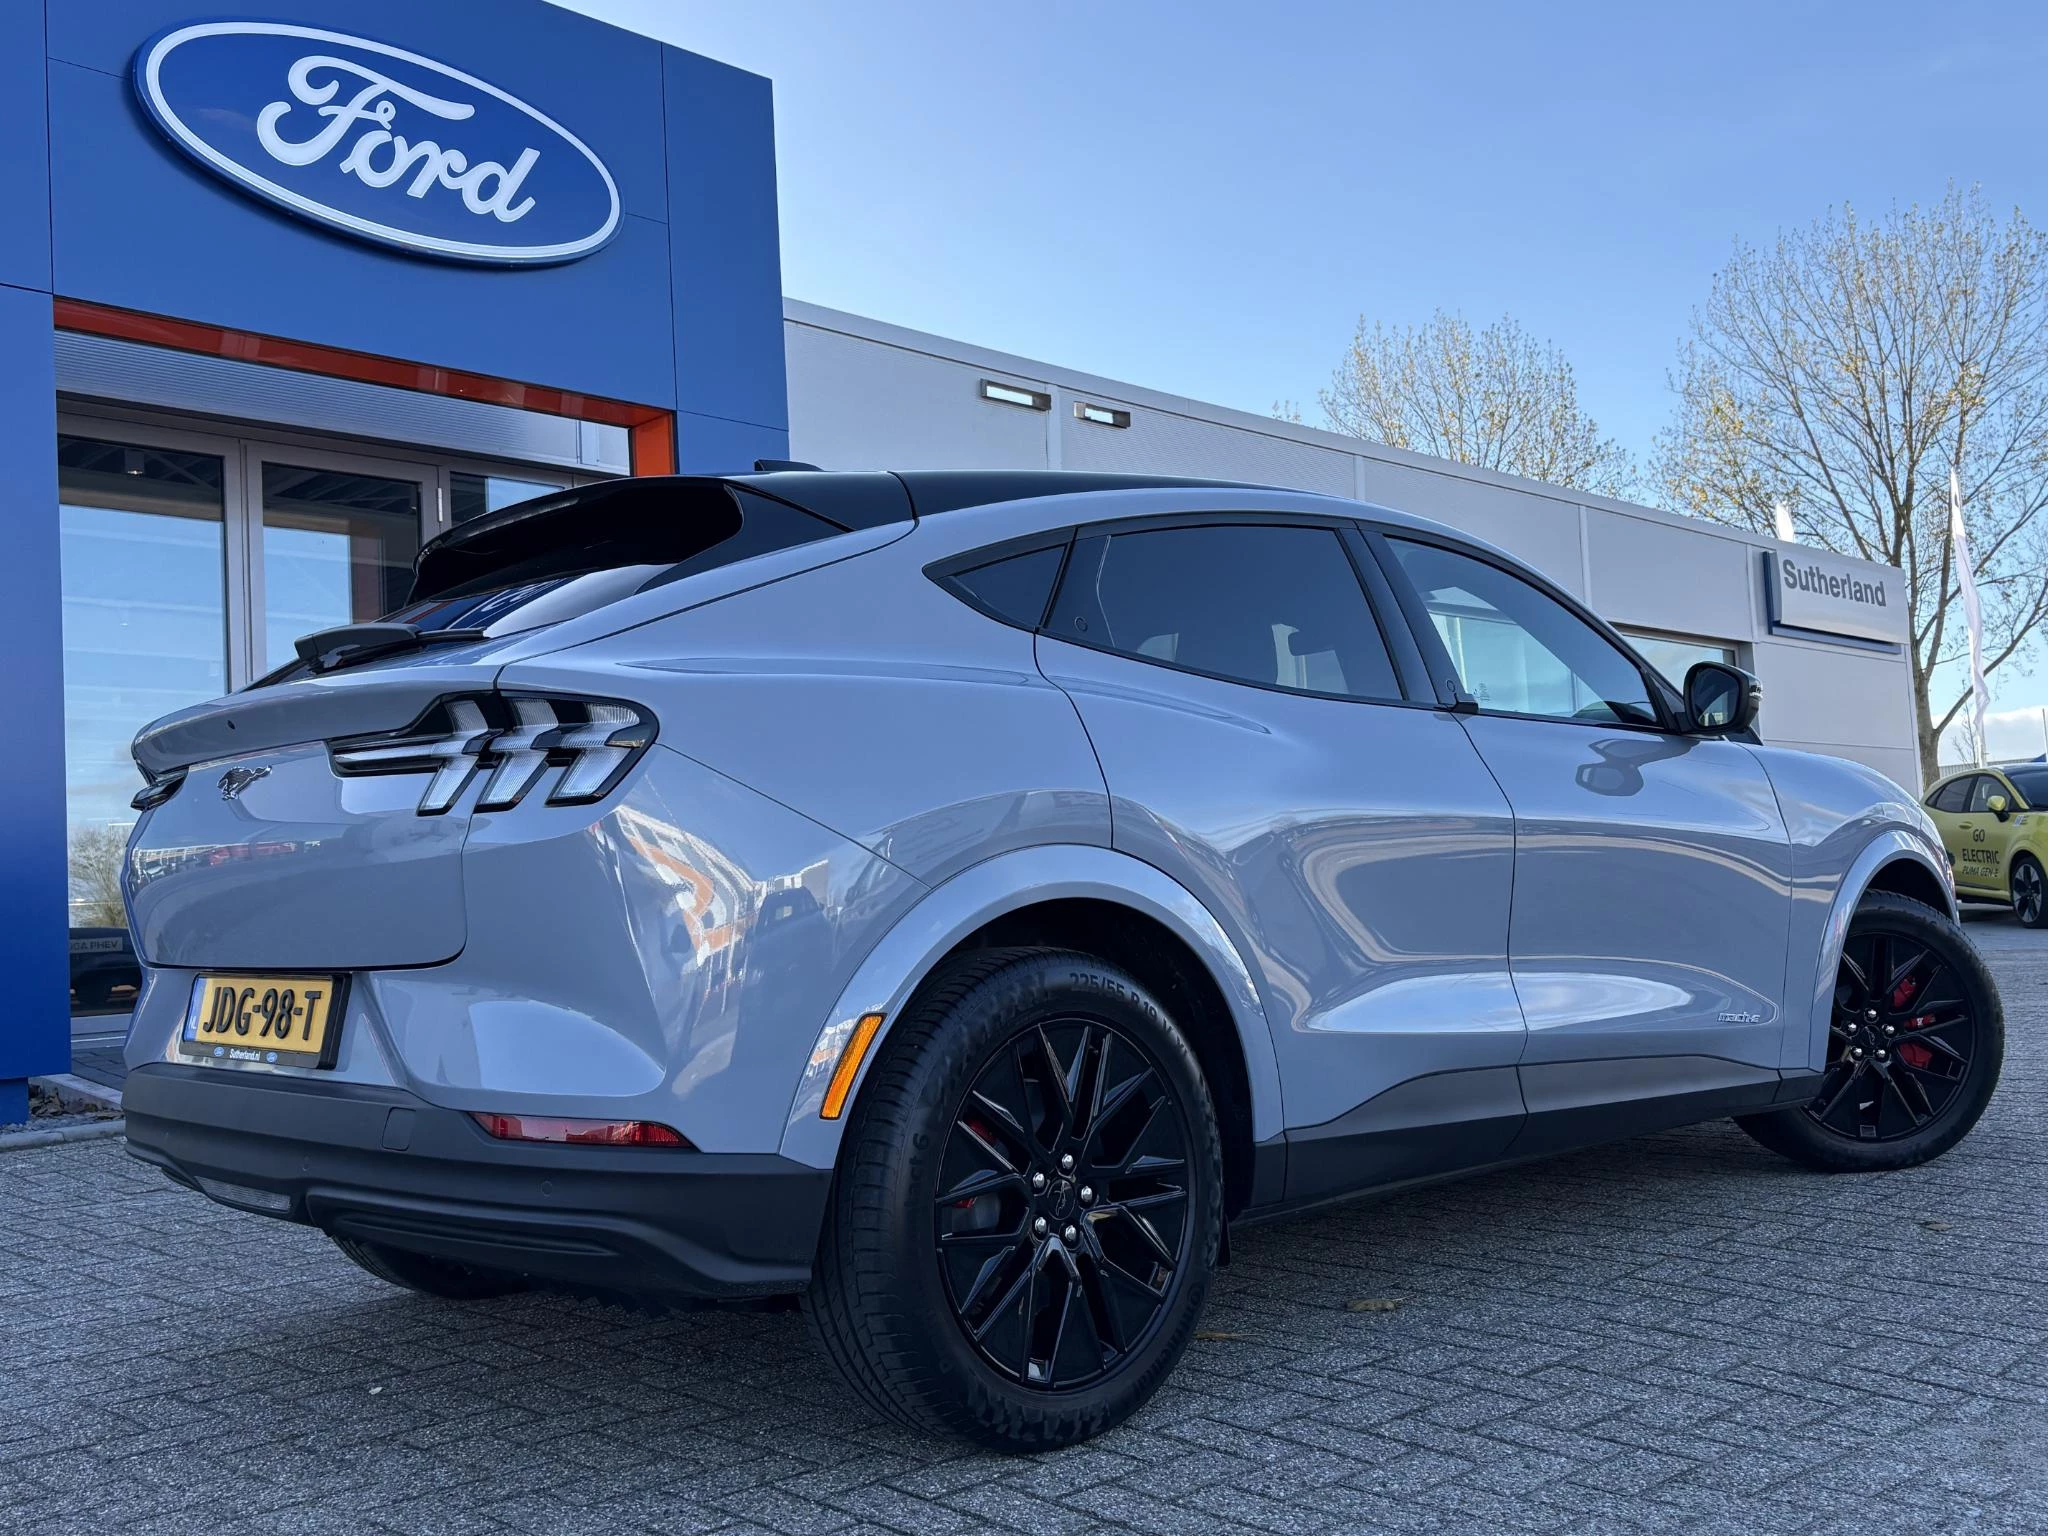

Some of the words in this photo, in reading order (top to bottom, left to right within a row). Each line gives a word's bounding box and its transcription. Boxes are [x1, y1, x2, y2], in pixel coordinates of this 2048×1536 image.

[257, 55, 541, 223] Ford
[1782, 559, 1887, 607] Sutherland
[1962, 849, 2000, 864] ELECTRIC
[1973, 829, 1985, 842] GO
[203, 986, 322, 1041] JDG-98-T
